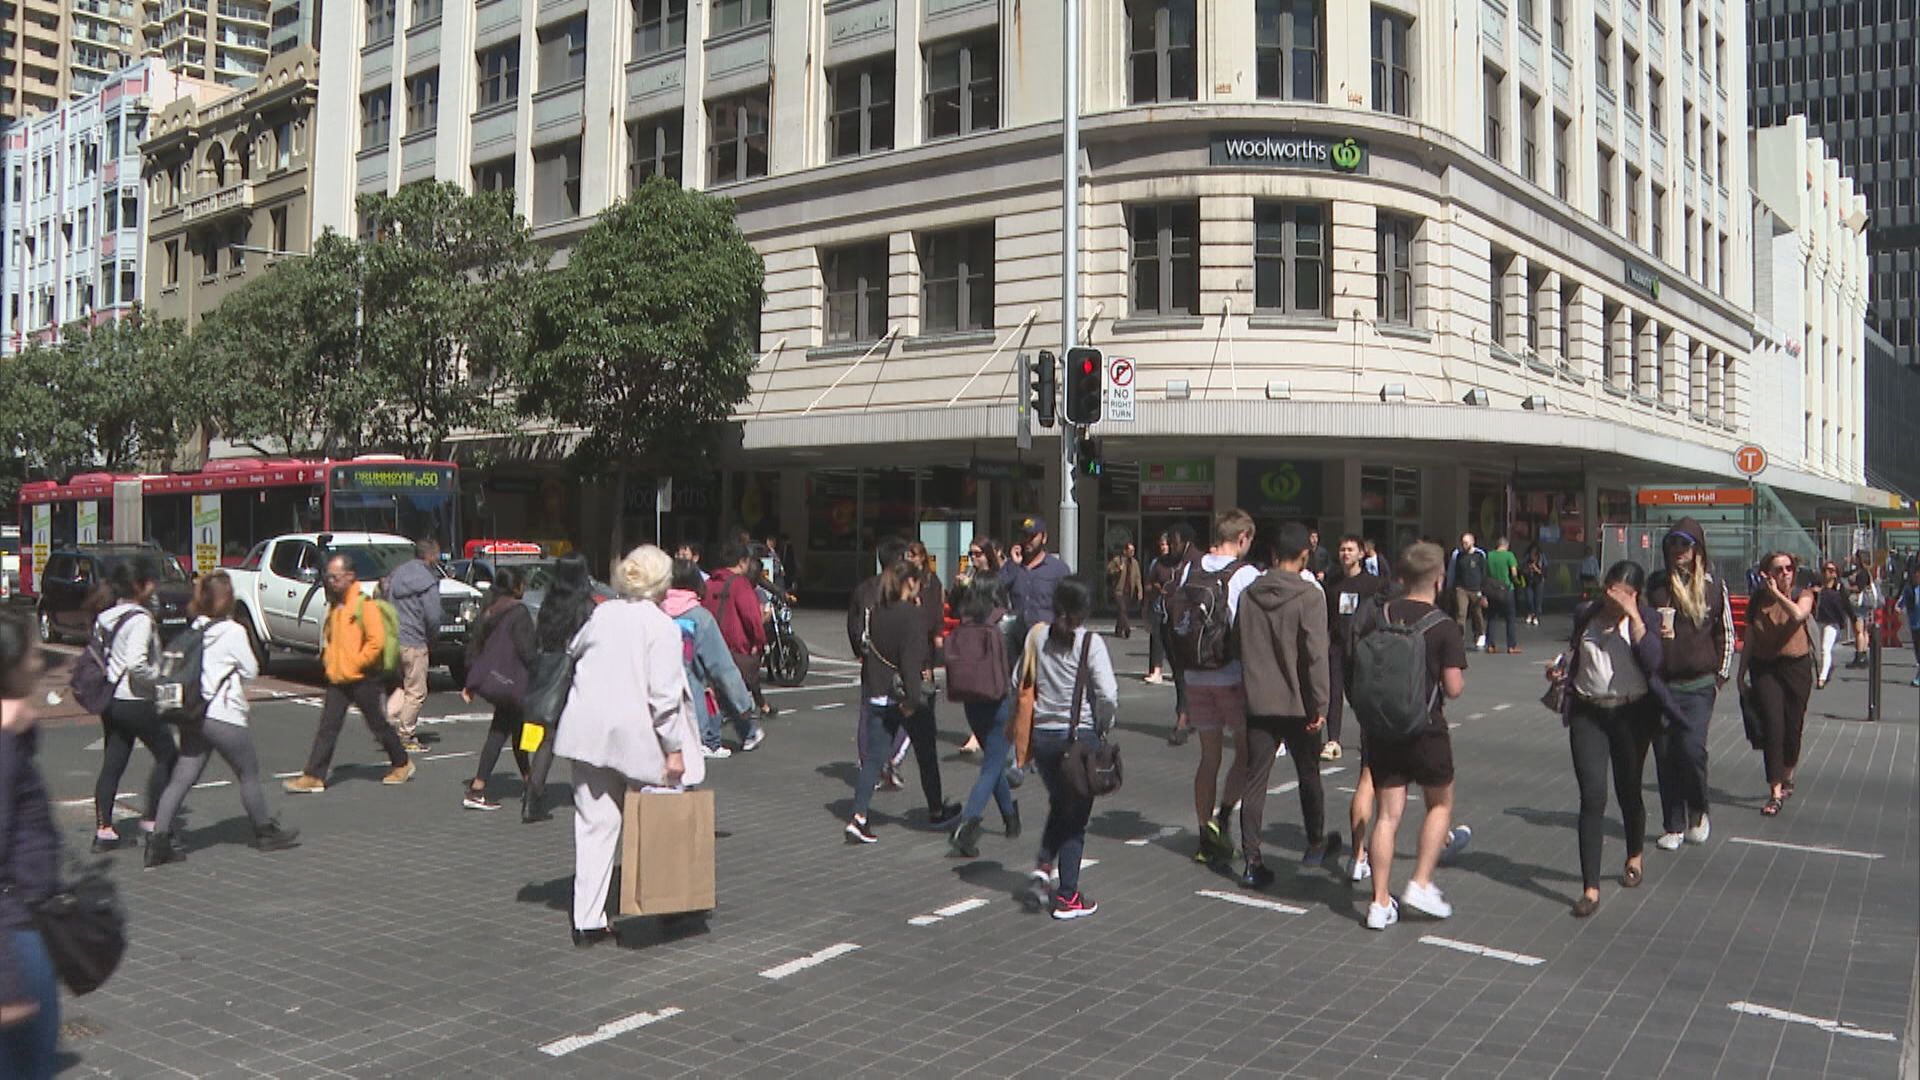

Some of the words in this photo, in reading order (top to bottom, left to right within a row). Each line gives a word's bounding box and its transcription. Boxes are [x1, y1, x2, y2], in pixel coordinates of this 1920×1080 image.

[1226, 136, 1326, 160] Woolworths
[1113, 388, 1129, 399] NO
[1110, 400, 1132, 408] RIGHT
[1111, 409, 1132, 418] TURN
[1743, 452, 1757, 470] T
[1673, 492, 1697, 502] Town
[1697, 492, 1716, 501] Hall
